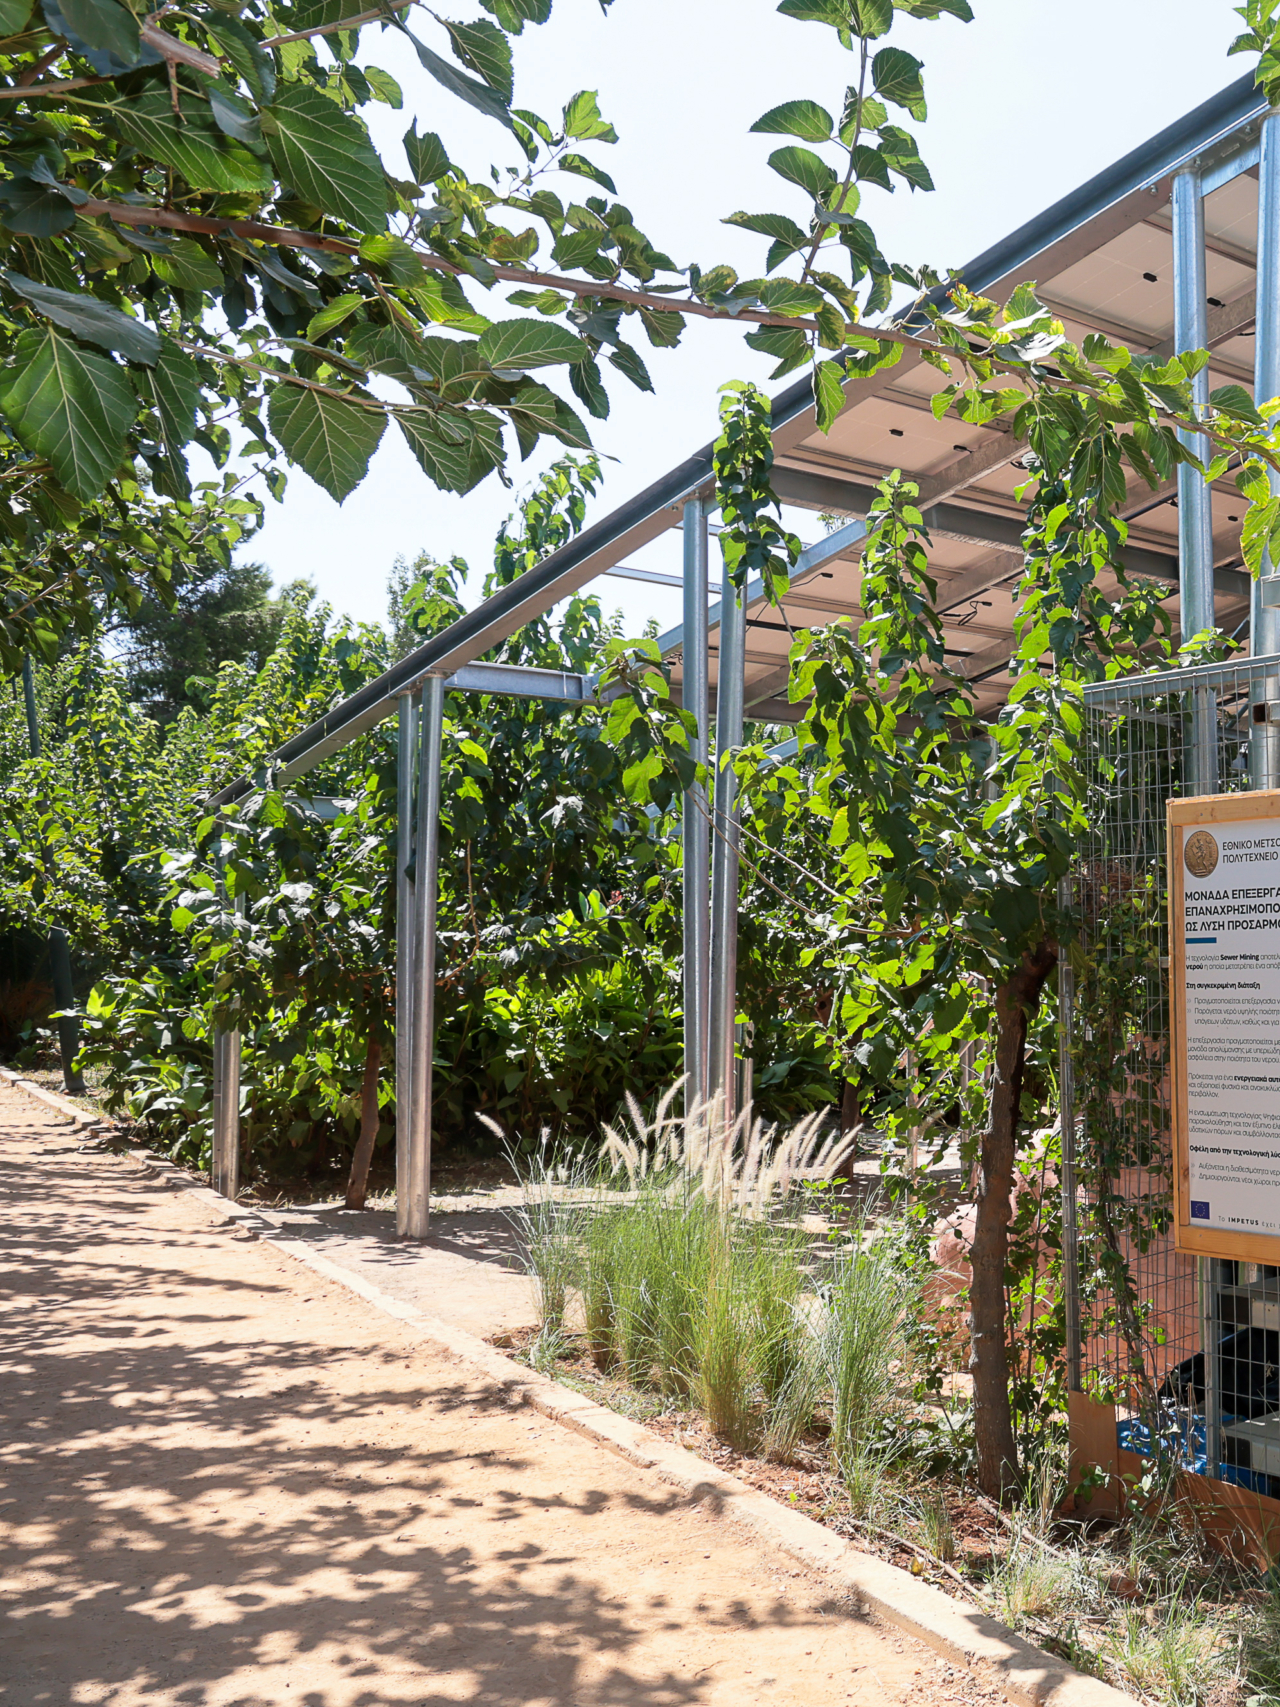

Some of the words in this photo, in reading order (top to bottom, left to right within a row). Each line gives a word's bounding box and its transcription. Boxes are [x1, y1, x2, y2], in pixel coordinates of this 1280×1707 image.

[1223, 840, 1252, 850] ΕΘΝΙΚΟ
[1223, 852, 1278, 863] ΠΟΛΥΤΕΧΝΕΙΟ
[1185, 890, 1229, 901] ΜΟΝΑΔΑ
[1186, 922, 1198, 931] ΩΣ
[1200, 921, 1224, 931] ΛΥΣΗ
[1228, 1217, 1259, 1225] IMPETUS
